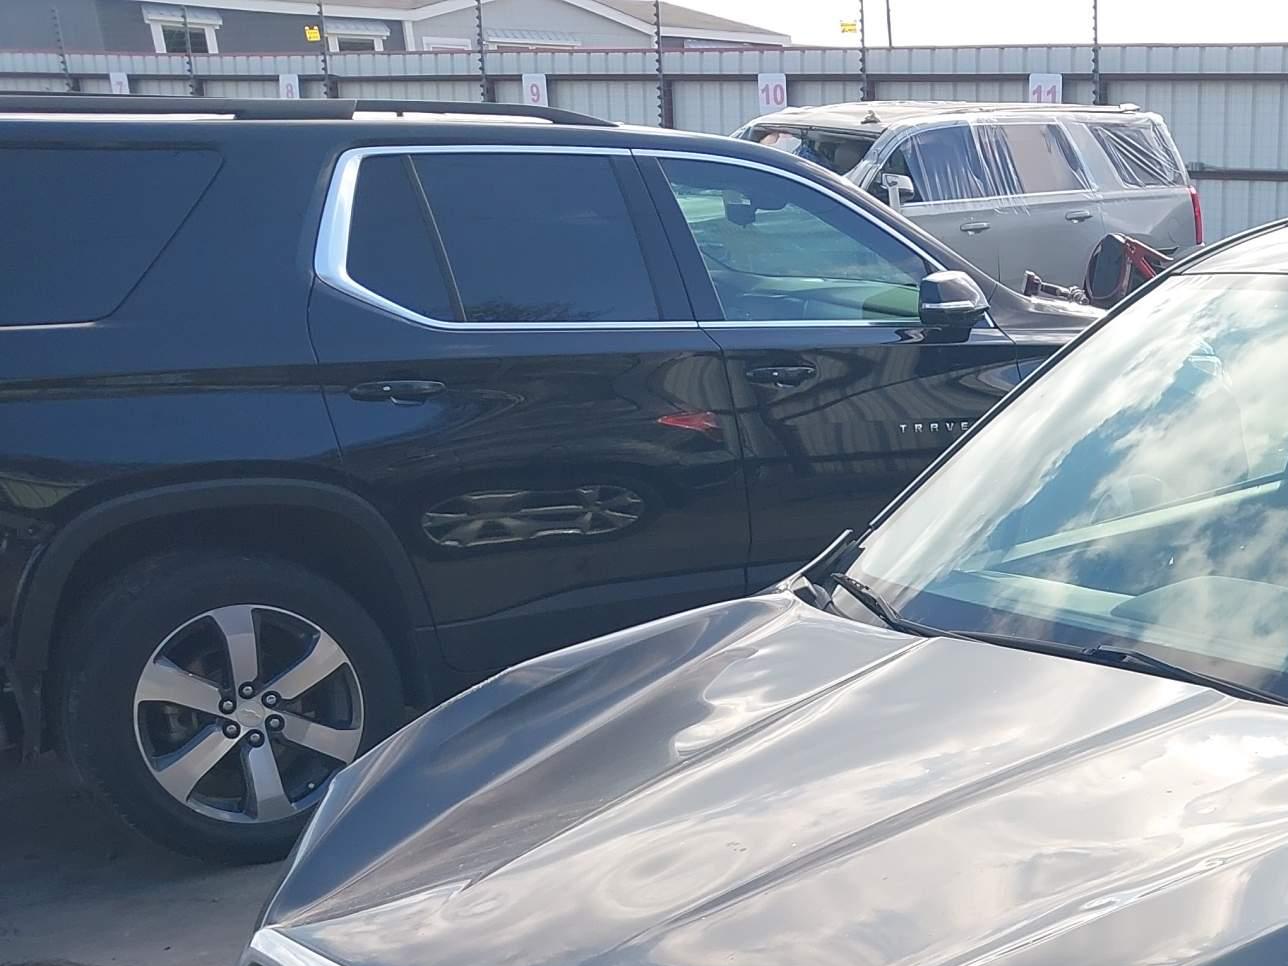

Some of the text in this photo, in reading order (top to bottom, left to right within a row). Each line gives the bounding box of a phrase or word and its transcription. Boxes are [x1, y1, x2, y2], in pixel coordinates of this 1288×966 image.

[530, 83, 540, 103] 9
[761, 83, 785, 105] 10
[1032, 84, 1056, 103] 11
